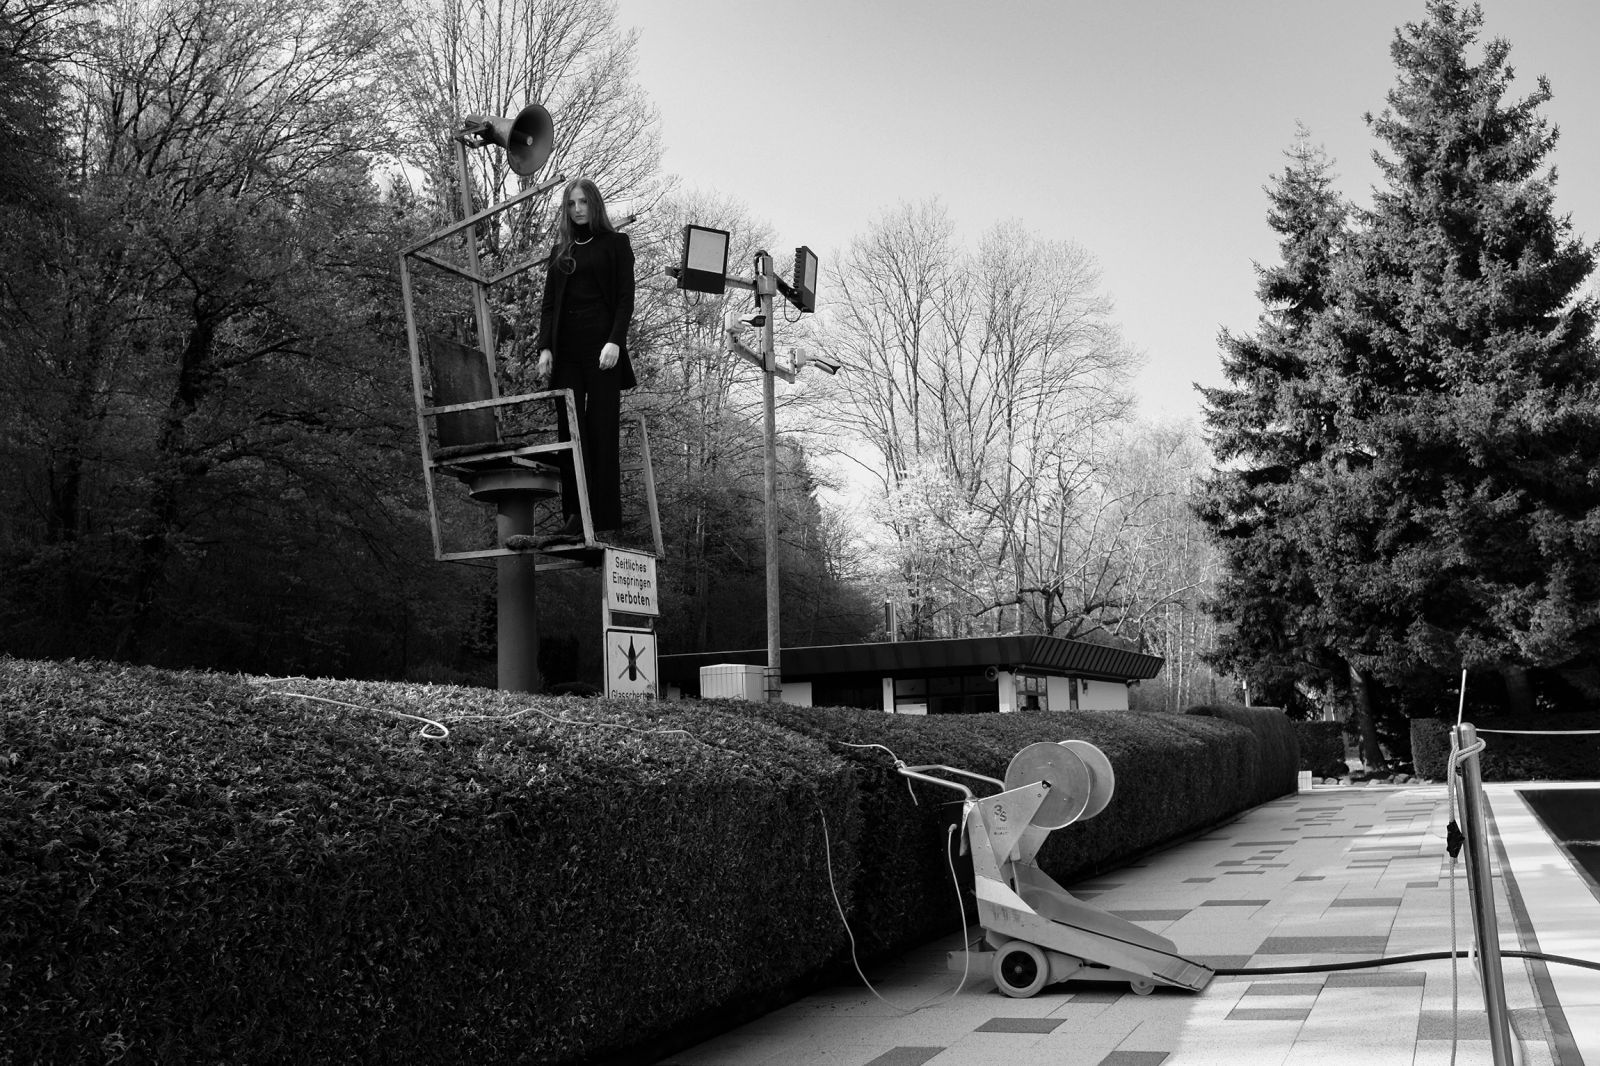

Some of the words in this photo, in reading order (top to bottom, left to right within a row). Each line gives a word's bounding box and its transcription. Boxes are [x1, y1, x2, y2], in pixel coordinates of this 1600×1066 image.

[615, 556, 647, 573] Seitliches
[612, 571, 652, 591] Einspringen
[615, 590, 651, 607] verboten
